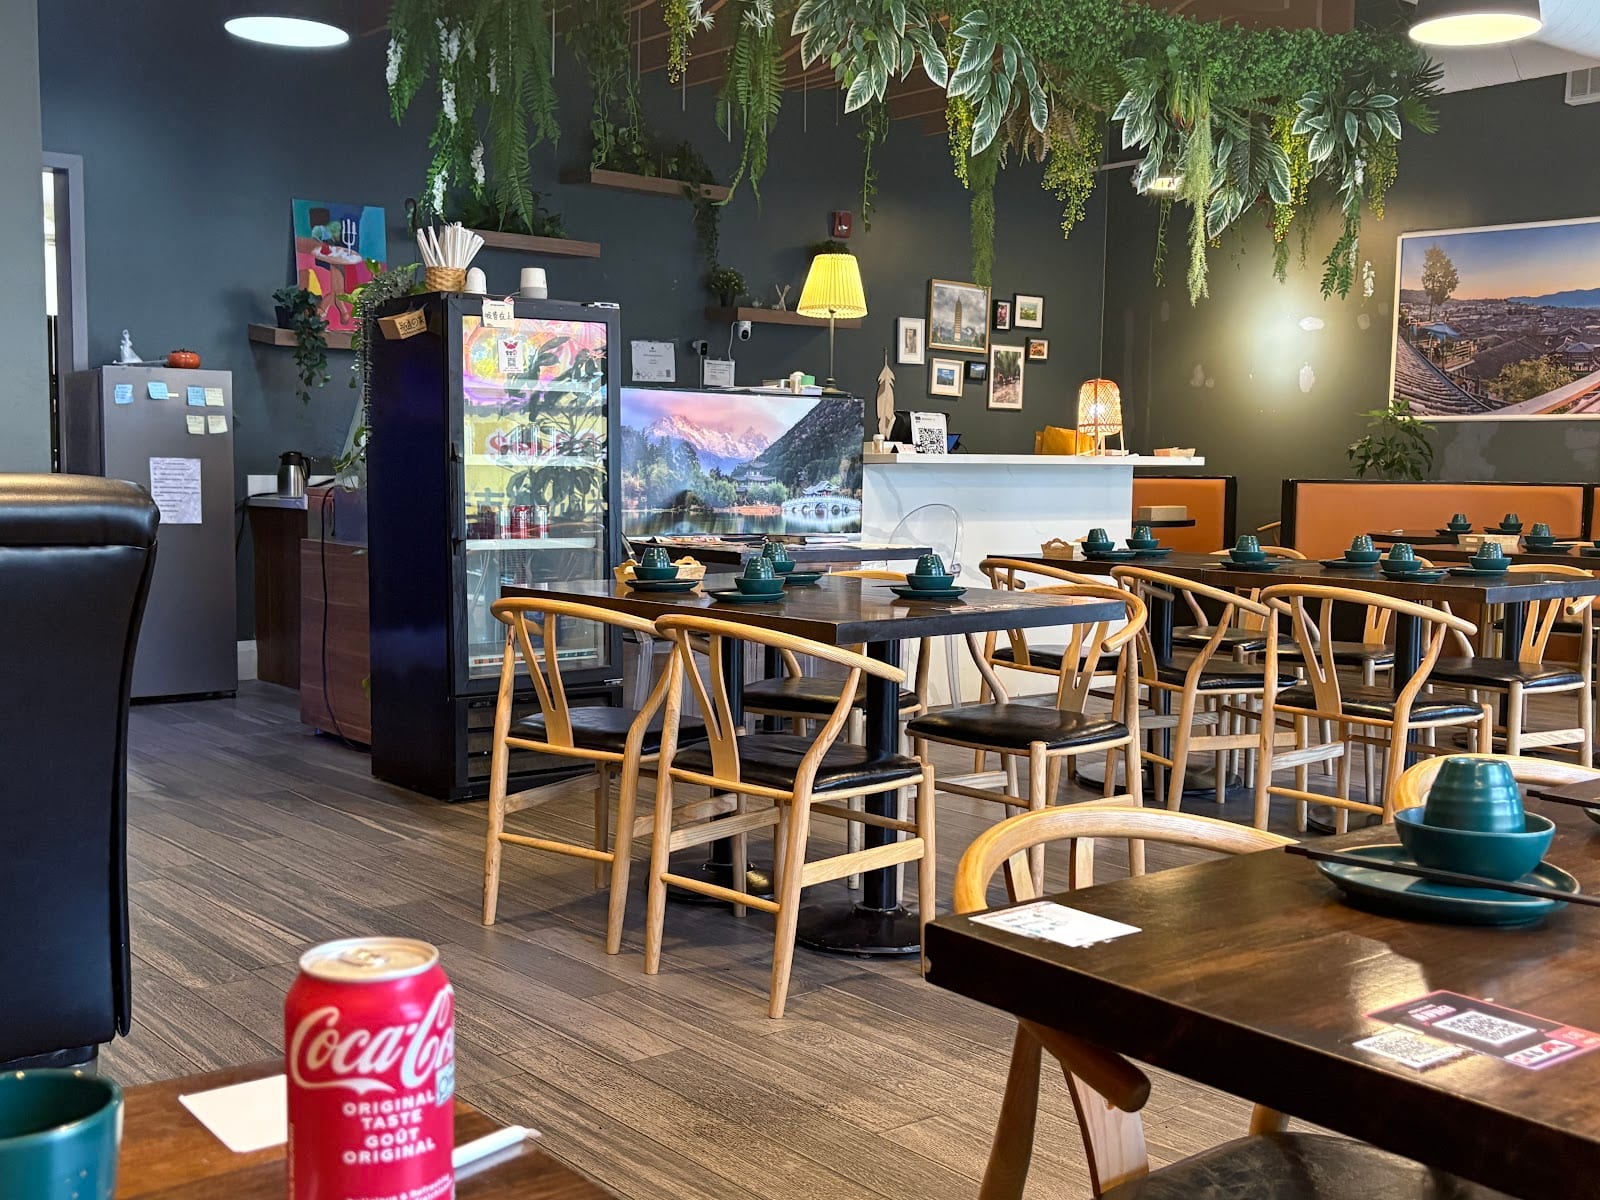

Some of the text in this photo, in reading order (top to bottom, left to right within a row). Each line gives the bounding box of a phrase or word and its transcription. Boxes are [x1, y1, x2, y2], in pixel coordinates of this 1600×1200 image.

[342, 1090, 435, 1116] ORIGINAL
[361, 1109, 422, 1130] TASTE
[364, 1127, 420, 1149] GOÛT
[342, 1137, 436, 1165] ORIGINAL
